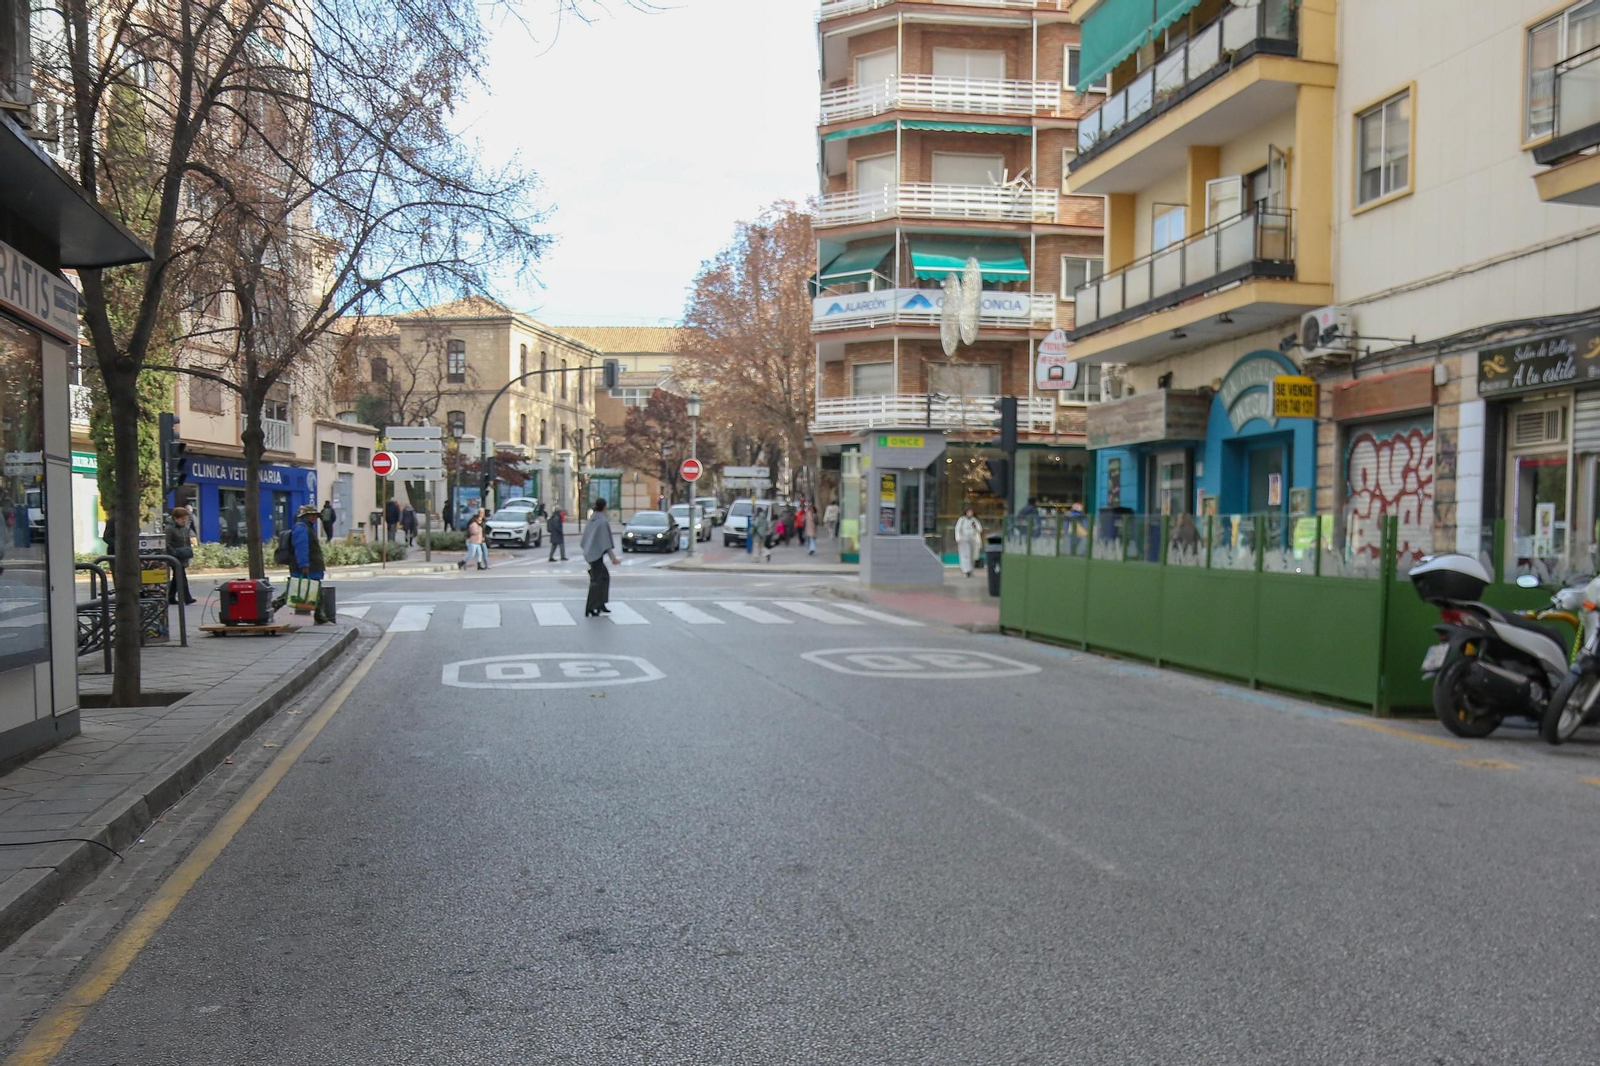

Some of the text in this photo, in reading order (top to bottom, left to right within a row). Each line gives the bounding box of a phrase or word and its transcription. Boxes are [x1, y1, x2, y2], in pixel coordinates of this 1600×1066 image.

[845, 297, 886, 312] ALARCÓN
[1512, 363, 1525, 388] A
[1543, 355, 1577, 383] estilo
[1276, 383, 1313, 397] SE VENDE
[891, 438, 919, 446] ONCE
[192, 463, 227, 479] CLINICA
[845, 653, 993, 670] 30
[485, 661, 621, 679] 30
